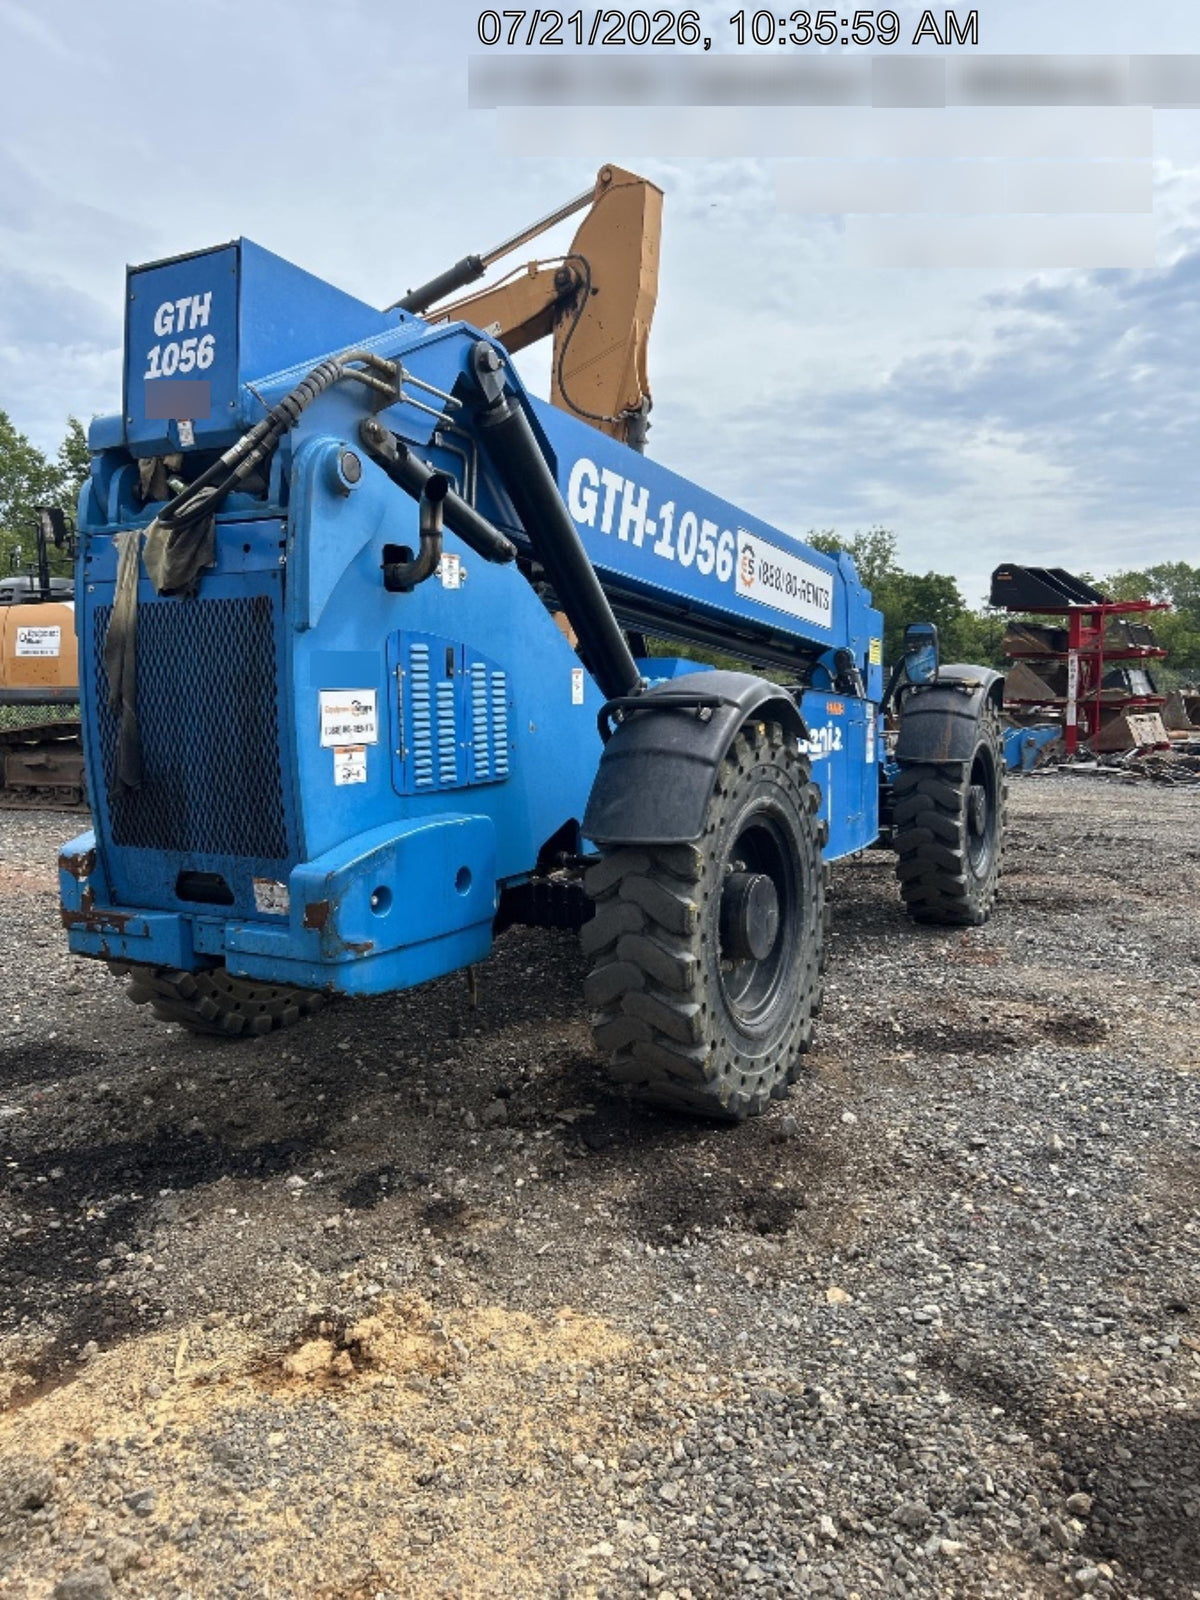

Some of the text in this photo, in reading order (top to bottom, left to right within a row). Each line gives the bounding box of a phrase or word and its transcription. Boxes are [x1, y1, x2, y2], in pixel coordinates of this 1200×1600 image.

[153, 290, 213, 337] GTH
[143, 333, 216, 380] 1056
[567, 457, 735, 583] GTH-1056
